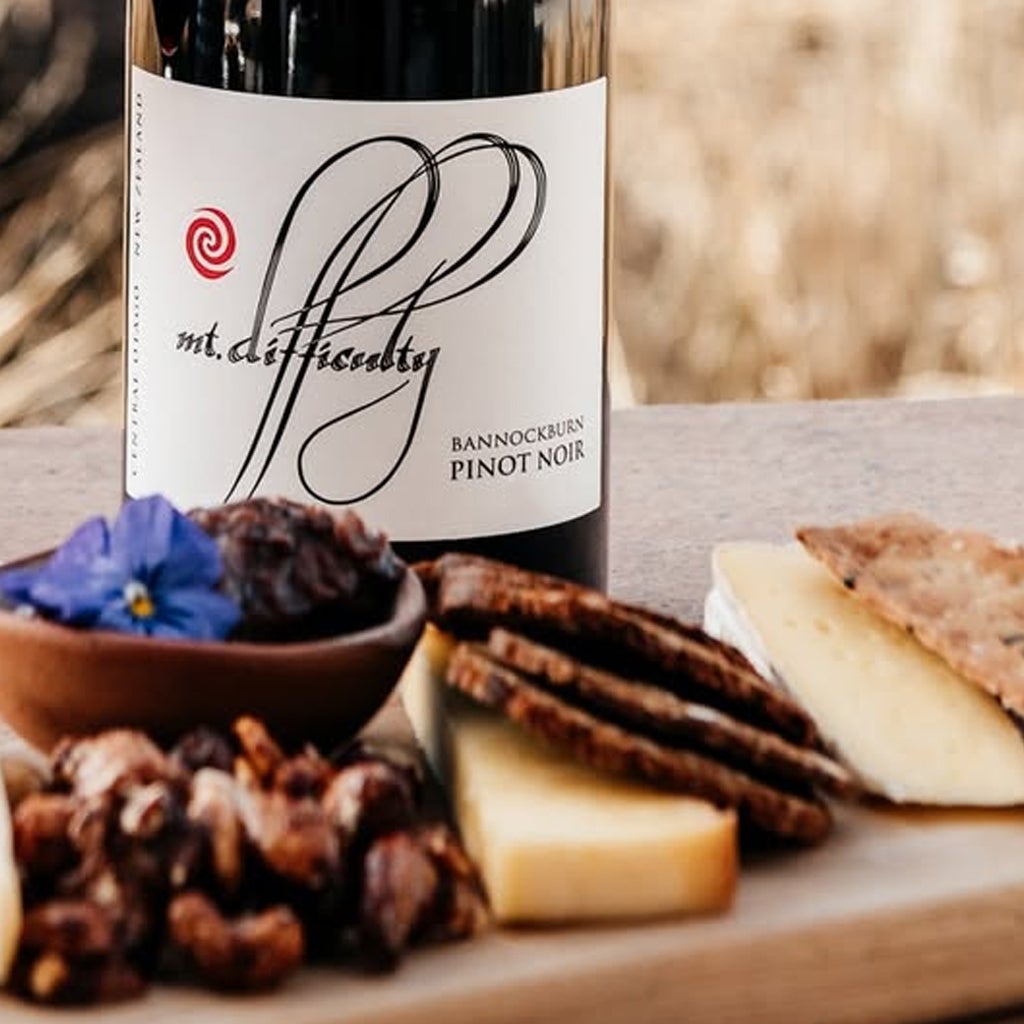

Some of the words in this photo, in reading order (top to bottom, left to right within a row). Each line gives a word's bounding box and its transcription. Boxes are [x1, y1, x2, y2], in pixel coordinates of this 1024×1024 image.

[451, 415, 585, 453] BANNOCKBURN
[450, 451, 532, 481] PINOT
[537, 439, 585, 470] NOIR
